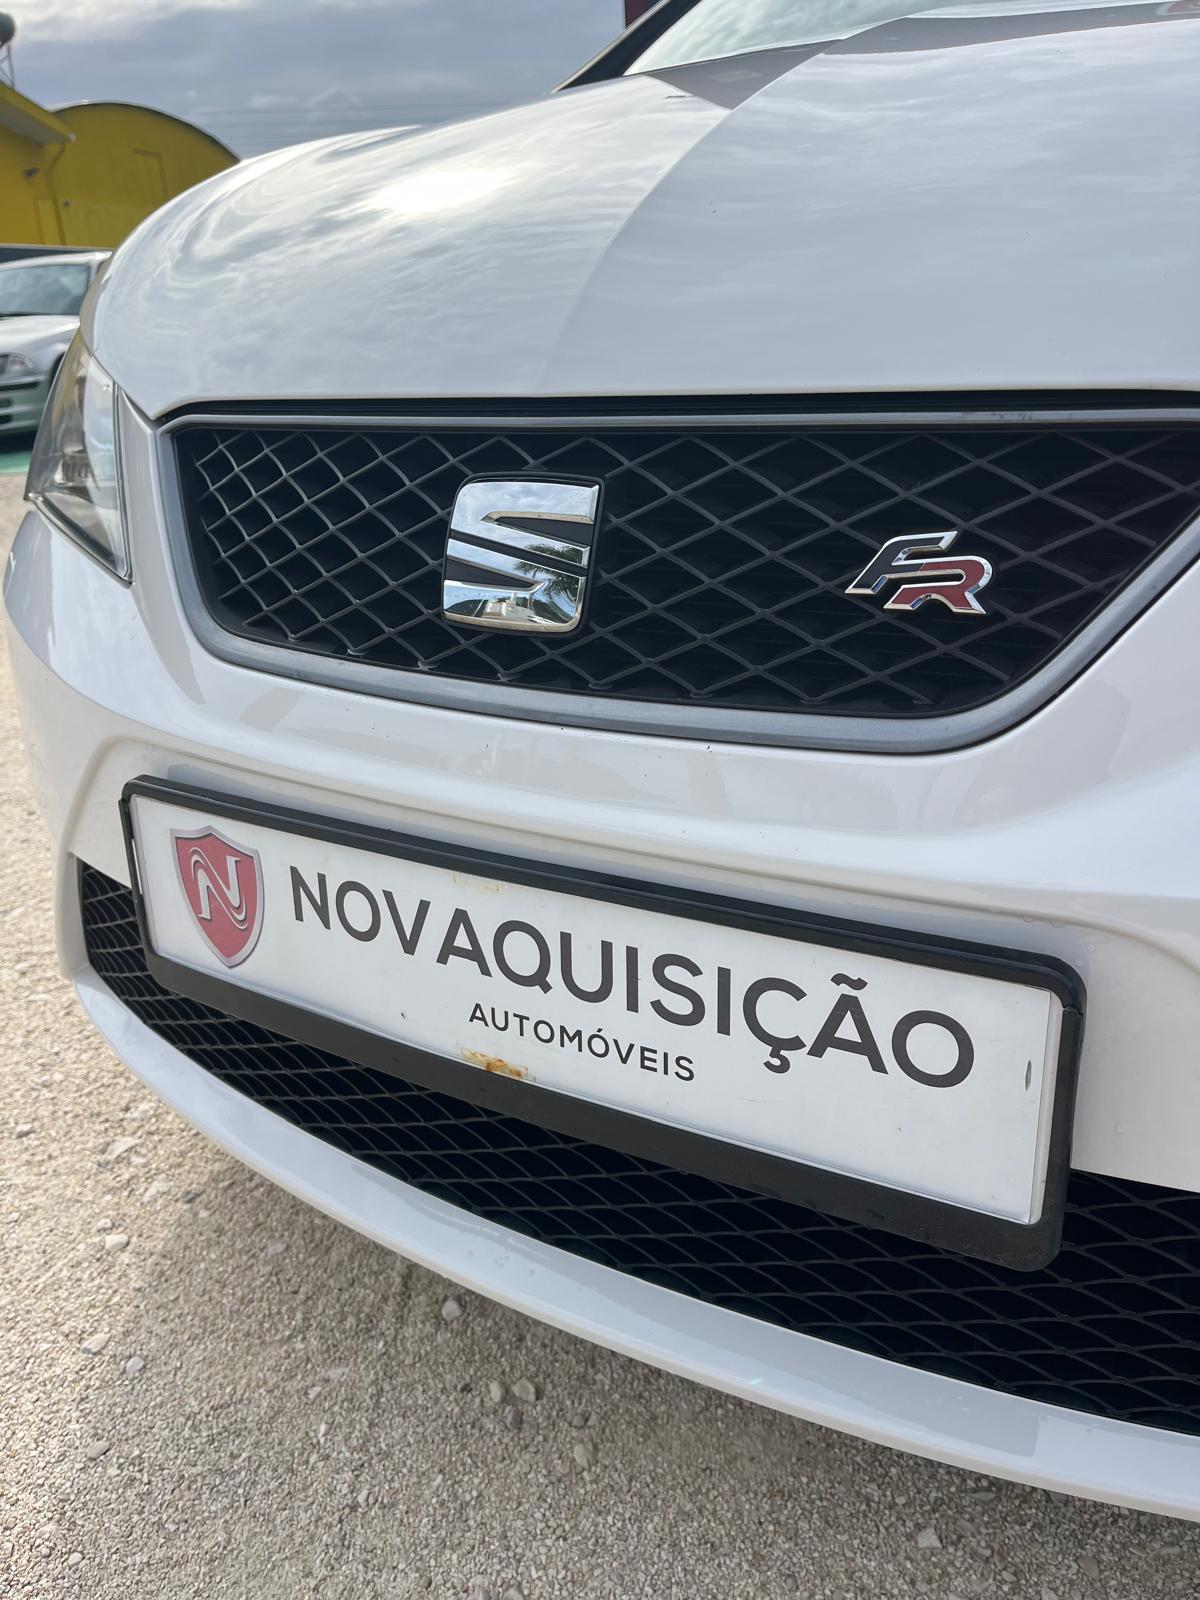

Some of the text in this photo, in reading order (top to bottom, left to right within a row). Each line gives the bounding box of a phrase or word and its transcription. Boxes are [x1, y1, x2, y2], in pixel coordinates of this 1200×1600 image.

[845, 530, 994, 615] FR
[289, 865, 975, 1088] NOVAQUISIÇÃO
[469, 1002, 695, 1082] AUTOMÓVEIS
